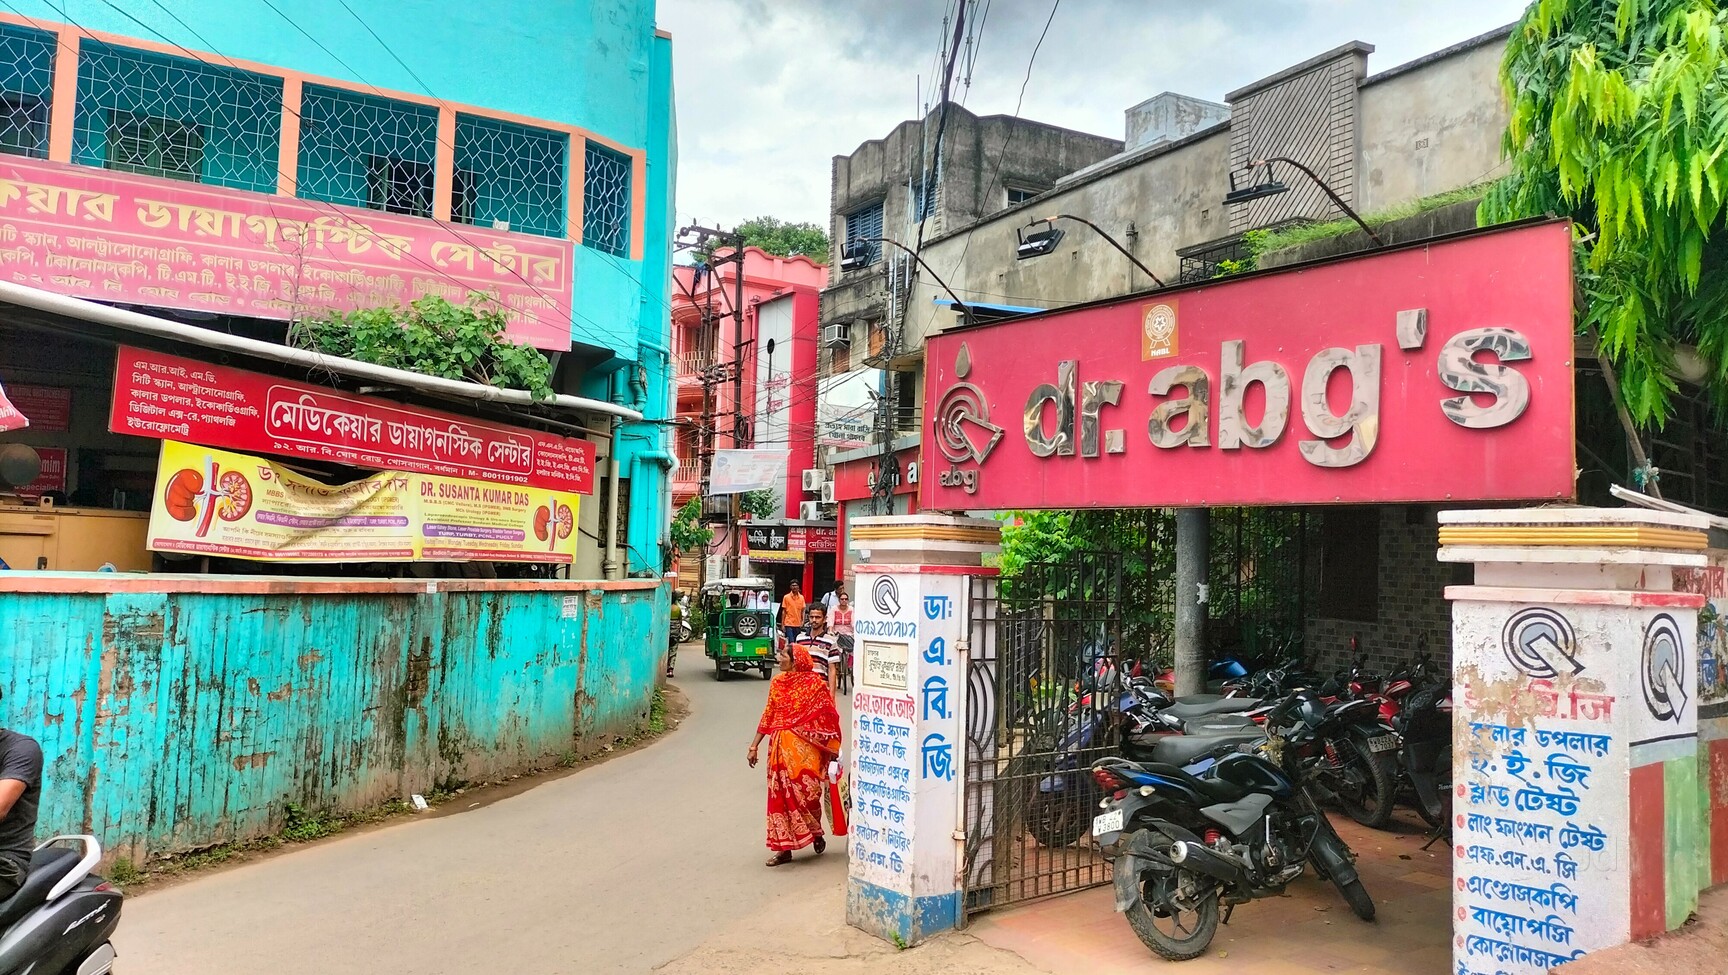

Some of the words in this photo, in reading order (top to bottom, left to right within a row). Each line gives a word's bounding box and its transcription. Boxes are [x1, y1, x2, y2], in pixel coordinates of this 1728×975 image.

[201, 253, 243, 271] কালার
[430, 240, 560, 284] সেন্টার
[132, 372, 151, 386] সিটি
[129, 400, 166, 416] ডিজিটাল
[130, 388, 158, 401] কালার
[1023, 360, 1127, 459] dr.
[271, 394, 382, 443] মেডিকেয়ার
[487, 436, 532, 467] সেন্টার
[482, 471, 528, 484] 8001191902
[938, 464, 981, 494] abg
[421, 481, 436, 497] DR.
[439, 483, 480, 502] SUSANTA
[482, 488, 512, 504] KUMAR
[514, 491, 529, 506] DAS
[1535, 729, 1612, 757] ডপলার
[1468, 812, 1492, 838] লাং
[1495, 817, 1554, 846] ফাংশন
[1469, 904, 1575, 946] বায়োপসি
